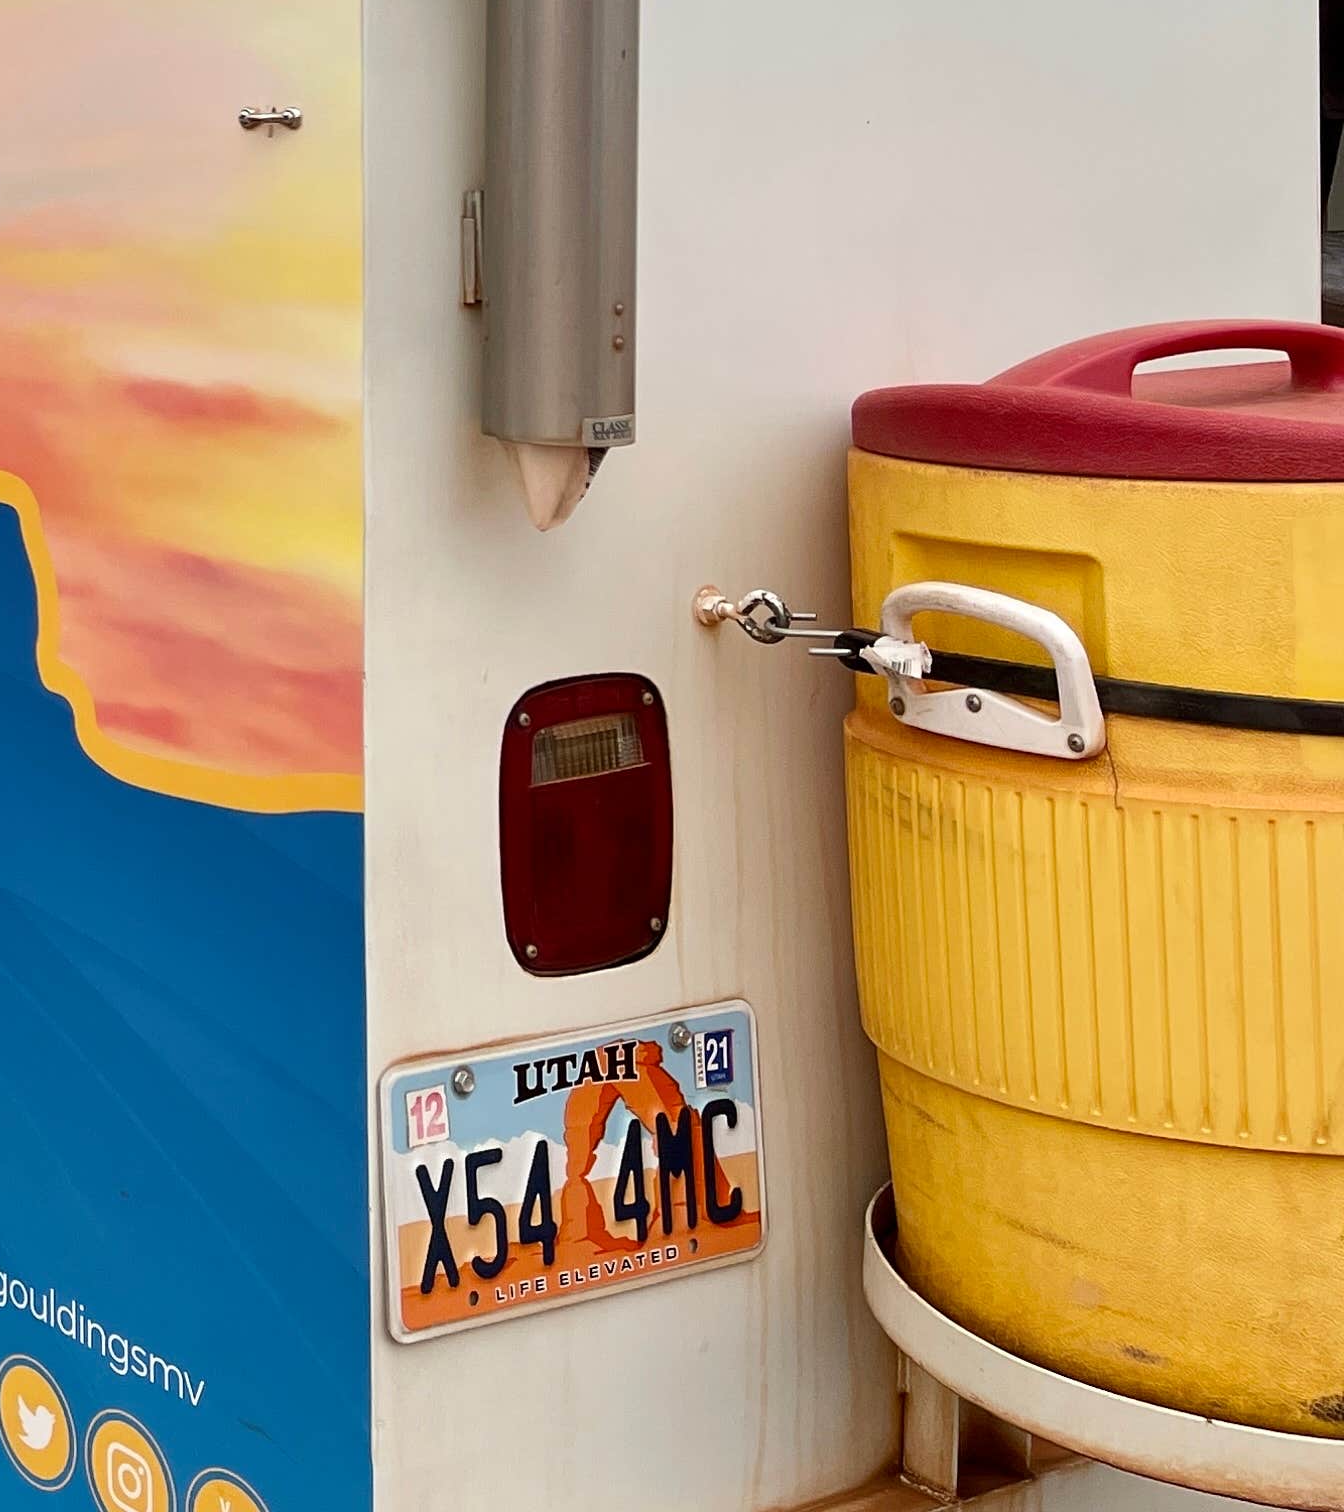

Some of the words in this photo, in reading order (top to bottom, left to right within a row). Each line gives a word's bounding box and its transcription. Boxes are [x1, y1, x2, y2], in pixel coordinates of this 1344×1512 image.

[513, 1040, 639, 1105] UTAH
[706, 1036, 728, 1072] 21
[410, 1091, 446, 1141] 12
[495, 1279, 548, 1302] LIFE
[559, 1246, 679, 1287] ELEVATED
